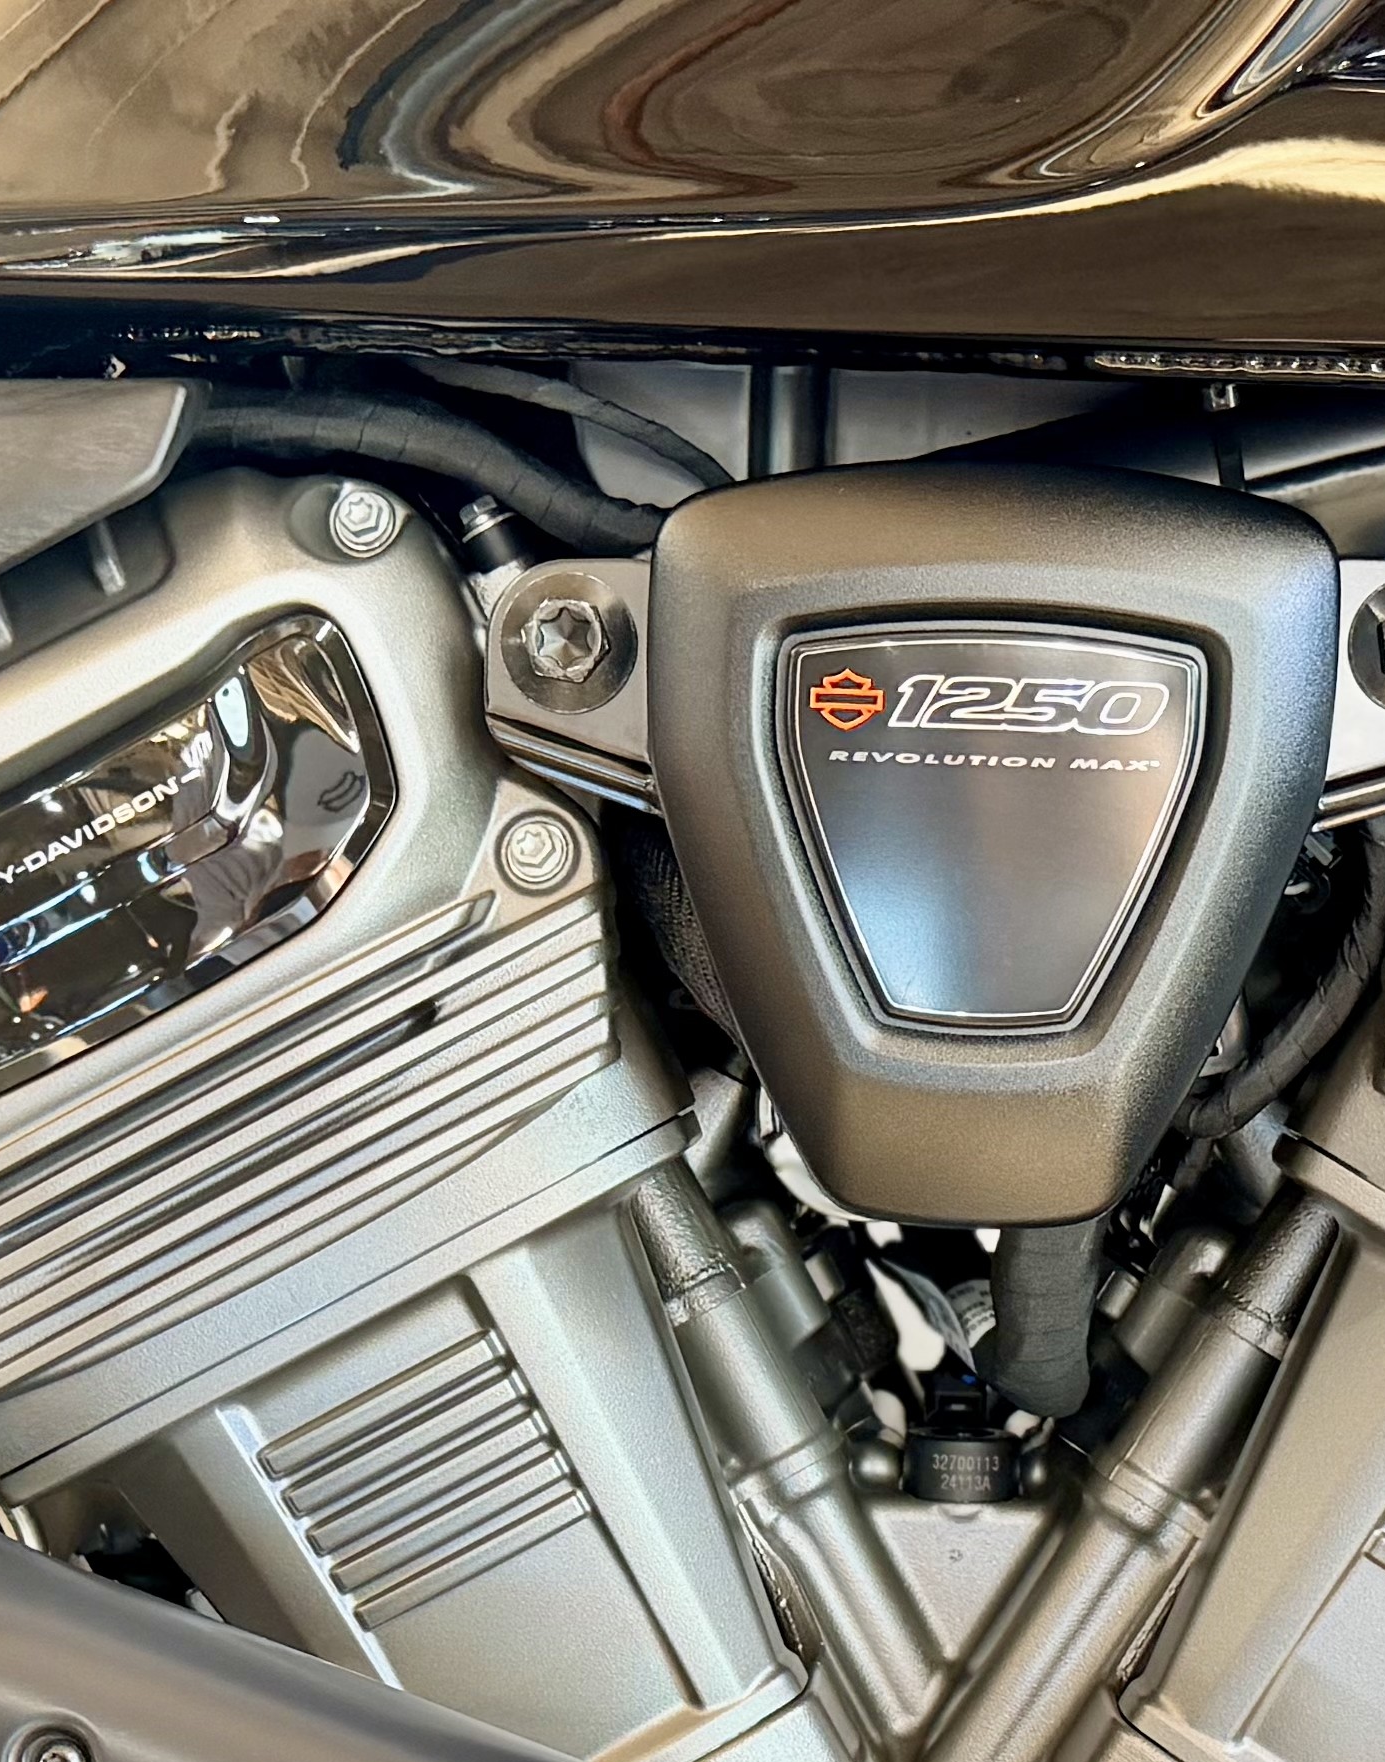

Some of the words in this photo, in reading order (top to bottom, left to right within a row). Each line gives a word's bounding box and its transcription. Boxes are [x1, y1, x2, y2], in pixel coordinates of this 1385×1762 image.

[887, 674, 1169, 735] 1250
[828, 750, 1056, 768] REVOLUTION
[932, 1454, 999, 1471] 32700113
